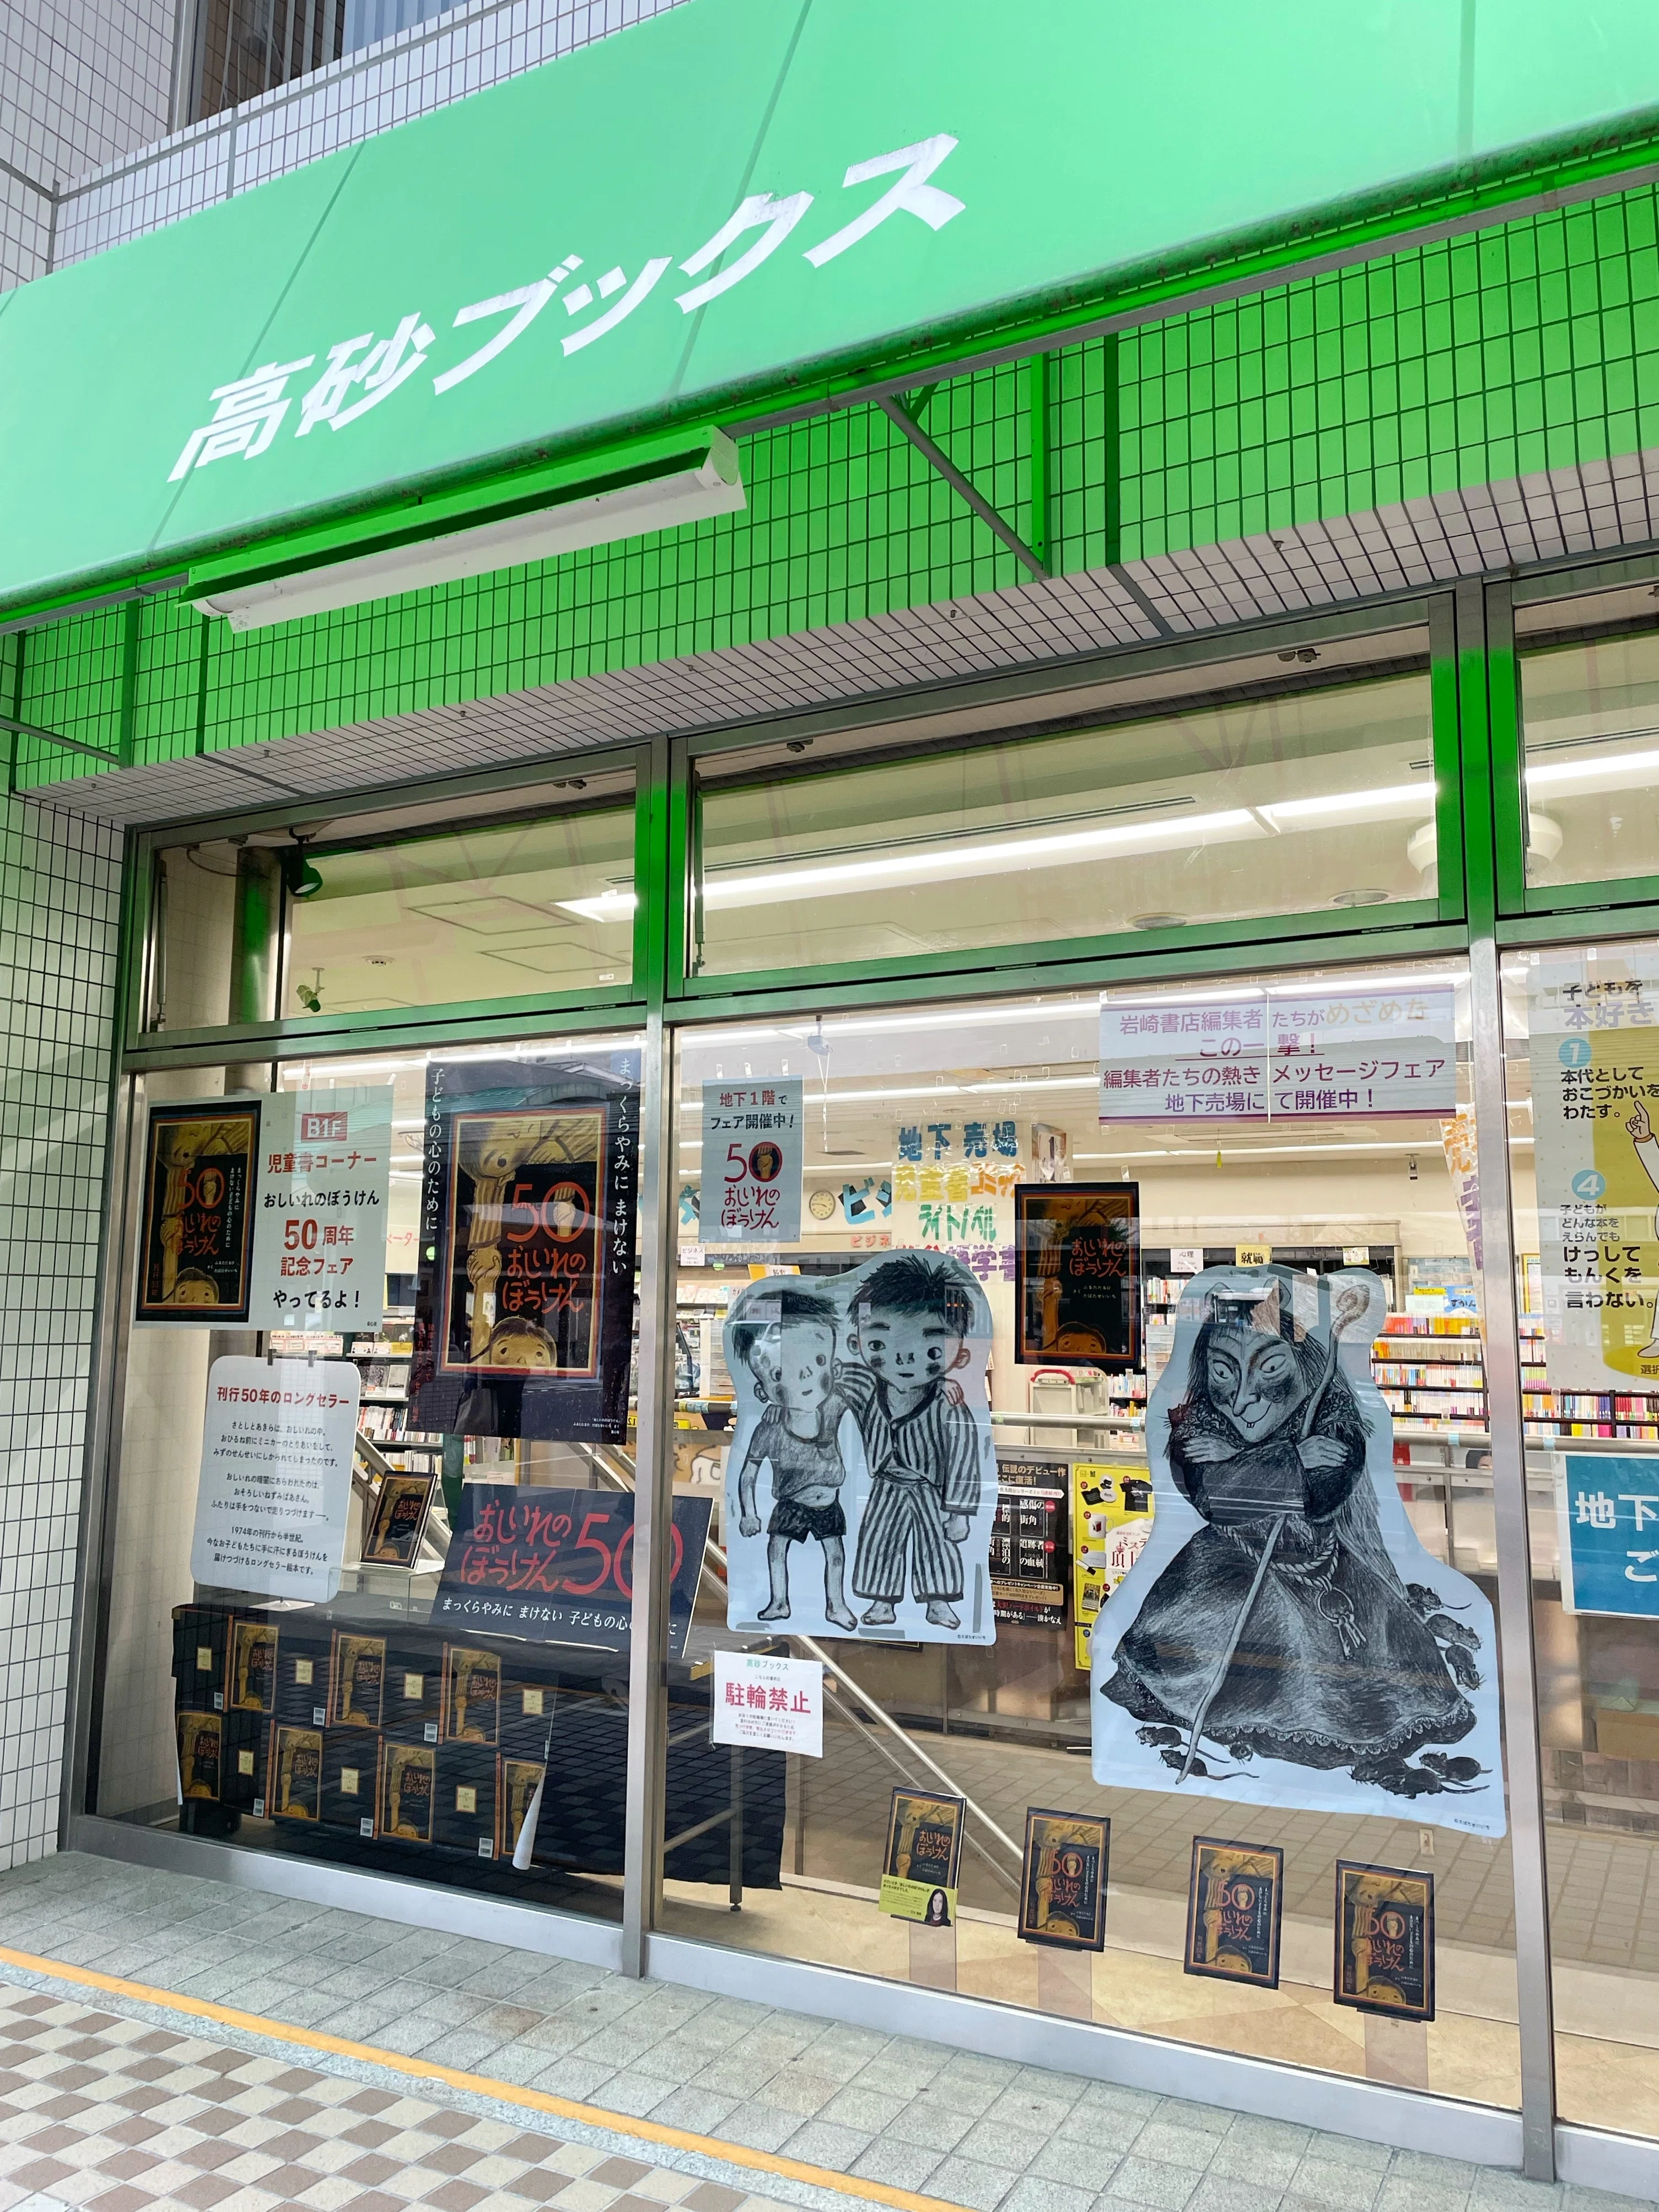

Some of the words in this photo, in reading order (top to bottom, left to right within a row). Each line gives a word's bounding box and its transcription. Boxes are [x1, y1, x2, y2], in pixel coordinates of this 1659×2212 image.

[167, 133, 966, 483] 高砂ブックス
[1563, 979, 1643, 1000] 子どもを
[1565, 1001, 1654, 1031] 本好き
[1569, 1043, 1581, 1064] 1
[1561, 1067, 1644, 1084] 本代として
[1563, 1084, 1659, 1101] おこづかいを
[1563, 1104, 1622, 1120] わたす。
[307, 1118, 342, 1138] B1F
[614, 1057, 633, 1191] まっくらやみに
[425, 1068, 445, 1231] 子どもの心のために
[898, 1121, 1018, 1161] 地下売場
[267, 1151, 377, 1174] 児童書コーナー
[724, 1141, 783, 1183] 50
[177, 1167, 225, 1209] 50
[724, 1184, 780, 1207] おしいれの
[1576, 1175, 1599, 1197] 4
[263, 1190, 380, 1208] おしいれのぼうけん
[1560, 1204, 1607, 1215] 子どもが
[507, 1181, 590, 1243] 50
[721, 1207, 779, 1230] ぼうけん
[1561, 1218, 1619, 1229] どんな本を
[284, 1219, 354, 1251] 50周年
[612, 1198, 628, 1275] まけない
[1562, 1231, 1620, 1242] えらんでも
[1071, 1236, 1126, 1258] おしいれの
[1241, 1252, 1264, 1264] 就職
[1564, 1246, 1641, 1263] けっして
[281, 1256, 353, 1277] 記念フェア
[507, 1245, 586, 1279] おしいれの
[1069, 1257, 1127, 1278] ぼうけん
[1564, 1266, 1642, 1284] もんくを
[502, 1279, 585, 1314] ぼうけん
[1565, 1290, 1654, 1309] 言わない。
[217, 1386, 349, 1409] 刊行50年のロングセラー
[1575, 1491, 1659, 1532] 地下
[473, 1499, 572, 1547] おしいれの
[460, 1544, 559, 1592] ぼうけん
[443, 1597, 513, 1617] まっくらやみに
[519, 1606, 563, 1622] まけない
[746, 1659, 789, 1671] 高砂ブックス
[725, 1682, 811, 1714] 駐輪禁止
[919, 1829, 950, 1847] おしいれの
[917, 1843, 949, 1861] ぼうけん
